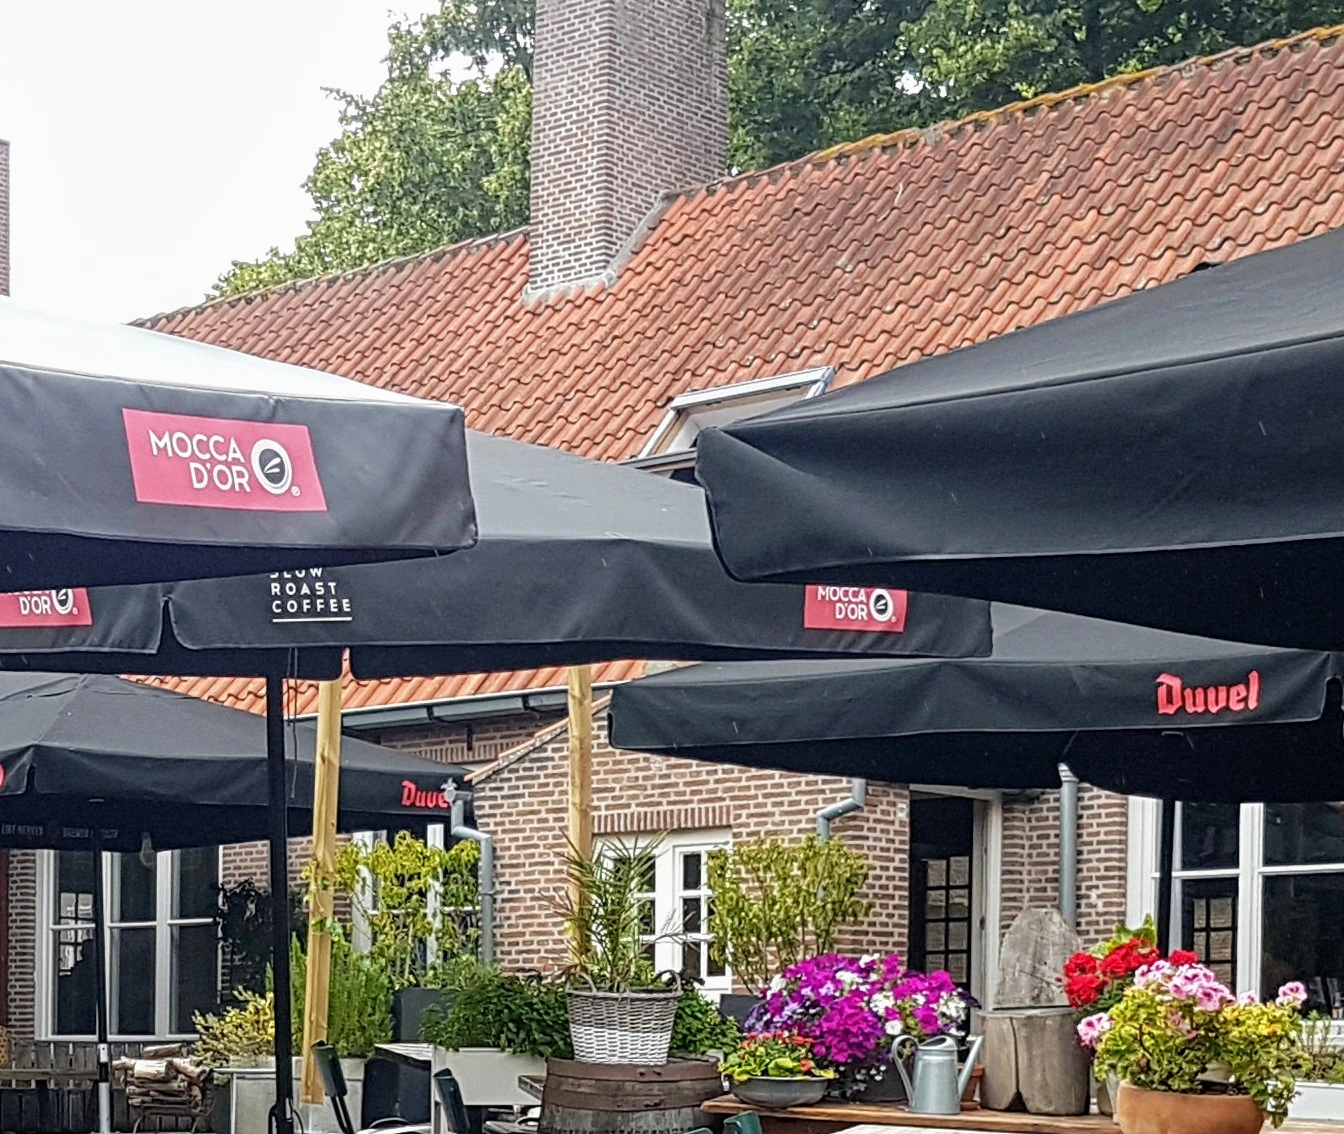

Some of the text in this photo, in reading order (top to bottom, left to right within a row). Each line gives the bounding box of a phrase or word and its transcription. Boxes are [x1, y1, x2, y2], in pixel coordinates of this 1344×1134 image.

[148, 429, 246, 464] MOCCA
[189, 461, 252, 493] D'OR
[270, 581, 337, 596] ROAST
[816, 586, 868, 603] MOCCA
[272, 598, 352, 613] COFFEE
[1155, 669, 1260, 715] Duvel
[402, 780, 453, 808] Duve
